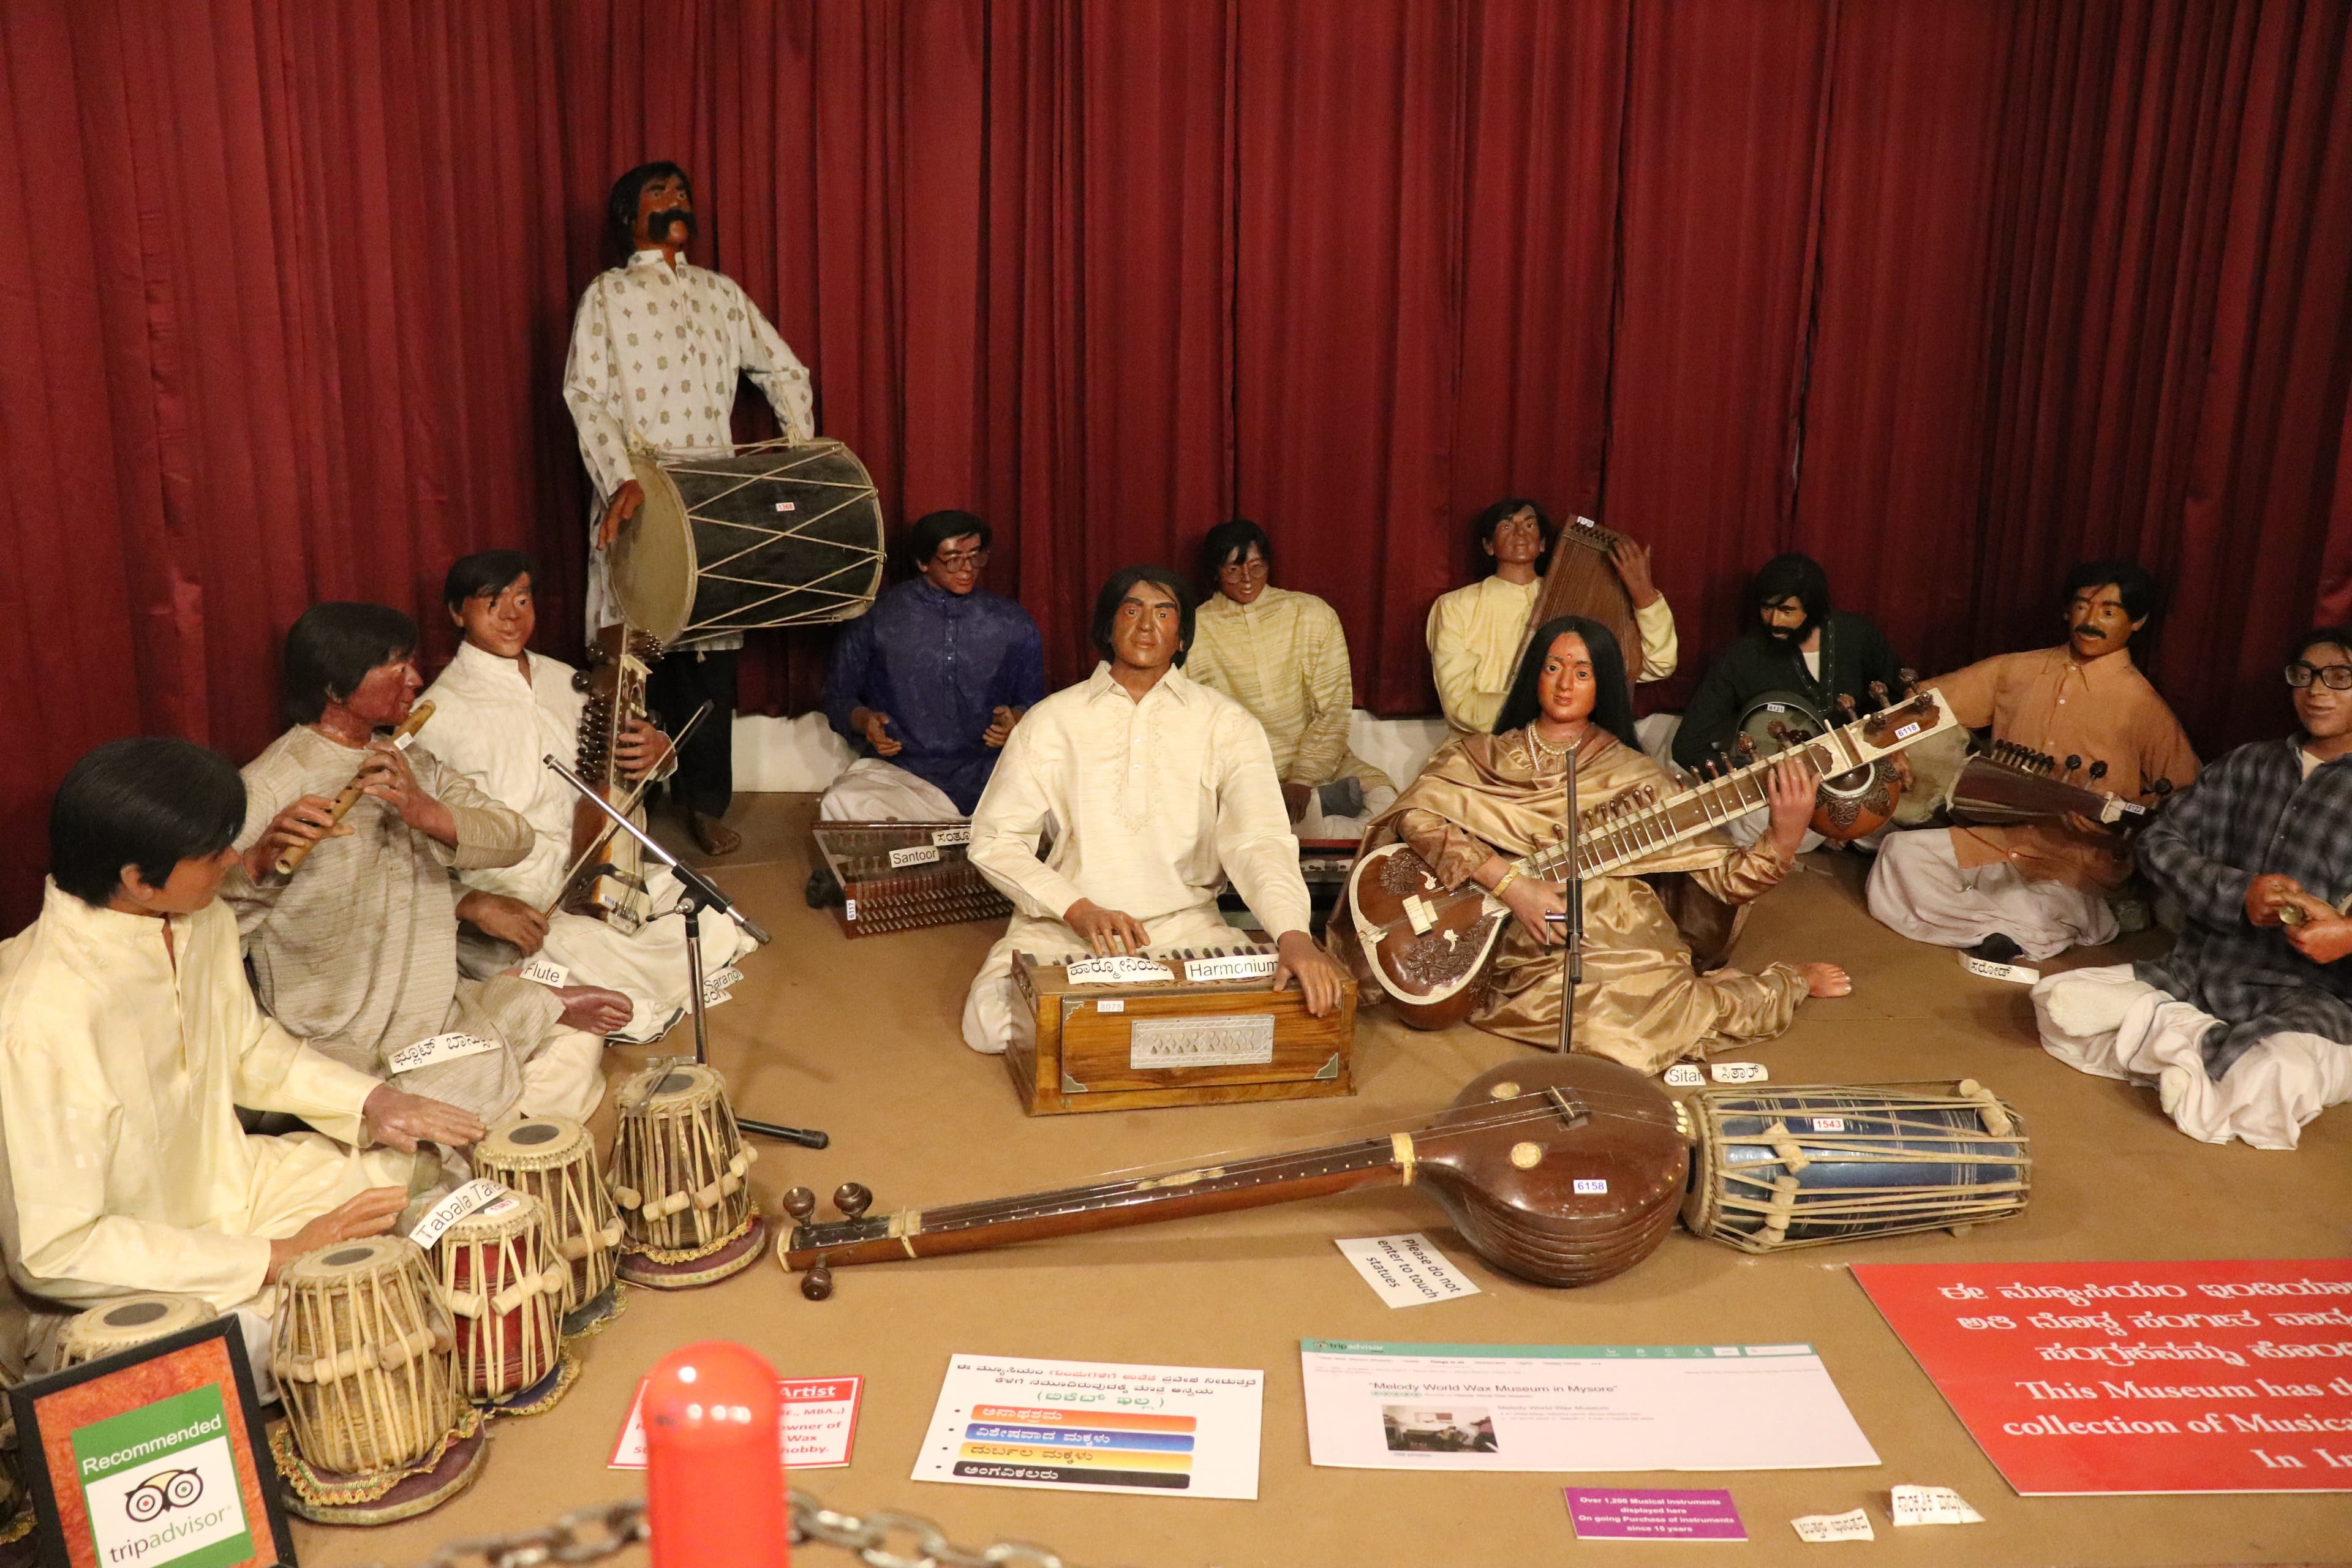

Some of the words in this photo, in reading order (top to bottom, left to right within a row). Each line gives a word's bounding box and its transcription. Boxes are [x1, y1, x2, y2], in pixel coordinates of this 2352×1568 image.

[1898, 724, 1917, 736] 6118
[937, 830, 971, 842] ಸಂತೂ
[893, 849, 937, 864] Santoor
[524, 963, 560, 982] Flute
[1190, 959, 1278, 978] Harmonium
[1669, 1069, 1702, 1083] Sitar
[1816, 1120, 1842, 1129] 1543
[1577, 1182, 1604, 1190] 6158
[415, 1196, 473, 1239] Tabala
[1366, 1256, 1400, 1288] statues
[1378, 1240, 1404, 1262] enter
[1399, 1264, 1413, 1273] to
[1409, 1274, 1439, 1298] touch
[1402, 1238, 1432, 1265] Please
[1428, 1265, 1444, 1277] do
[1439, 1278, 1461, 1293] not
[1937, 1282, 1989, 1300] ಈ
[1996, 1280, 2187, 1307] ಮ್ಯೂಸಿಯಂ
[2197, 1278, 2352, 1298] ಇಂಡಿಯಾ
[1956, 1315, 2018, 1330] ಅತಿ
[2026, 1311, 2128, 1336] ದೊಡ್ಡ
[2127, 1309, 2261, 1329] ಸಂಗೀತ
[2268, 1307, 2352, 1326] ವಾದ
[2034, 1341, 2251, 1367] ಸಂಗ್ರಹವನ್ನು
[780, 1385, 837, 1399] Artist
[2015, 1380, 2098, 1400] This
[2098, 1380, 2260, 1399] Museum
[2255, 1378, 2324, 1397] has
[2002, 1414, 2182, 1436] collection
[2187, 1412, 2228, 1434] of
[2225, 1412, 2352, 1433] Musica
[81, 1413, 222, 1476] Recommended
[2249, 1448, 2307, 1468] In
[109, 1508, 226, 1563] tripadvisor
